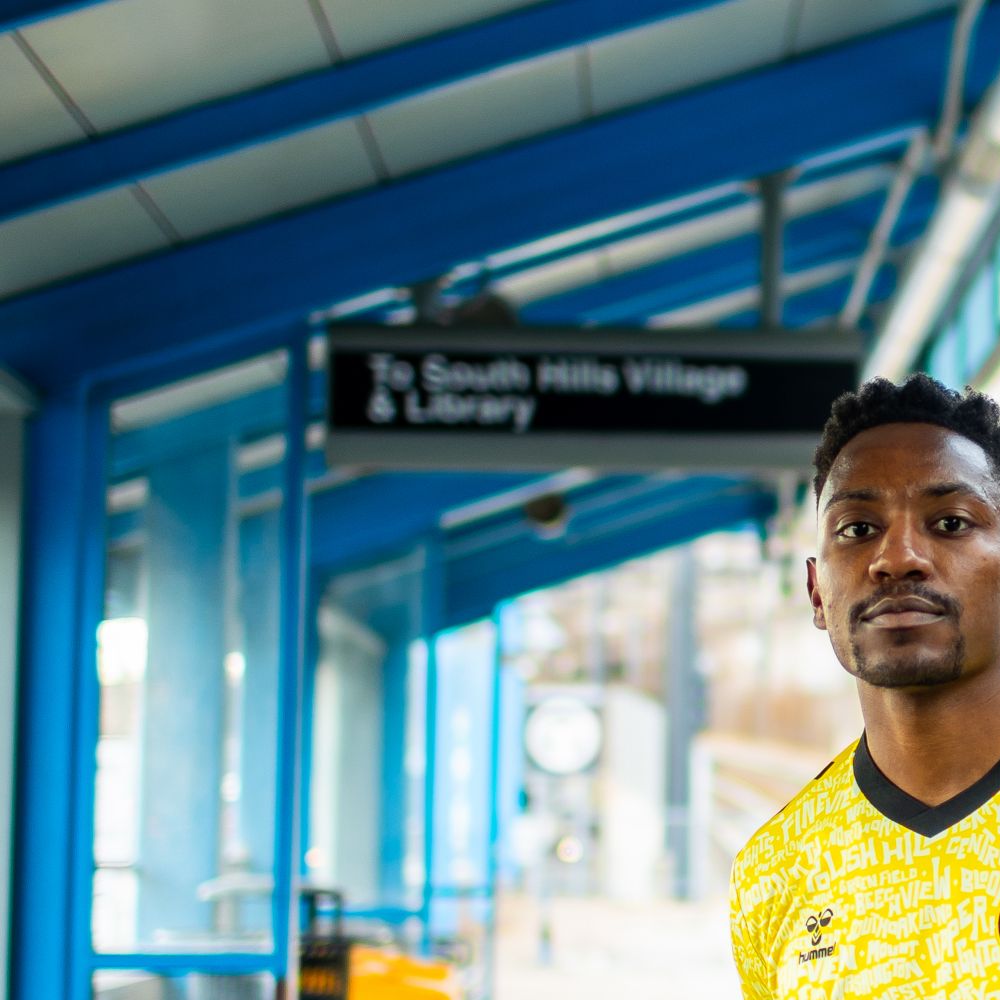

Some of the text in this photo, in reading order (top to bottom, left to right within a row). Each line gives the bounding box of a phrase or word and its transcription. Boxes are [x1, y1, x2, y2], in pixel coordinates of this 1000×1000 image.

[368, 353, 748, 403] To South Hills Village
[367, 392, 535, 434] & Library
[798, 941, 837, 965] hummel
